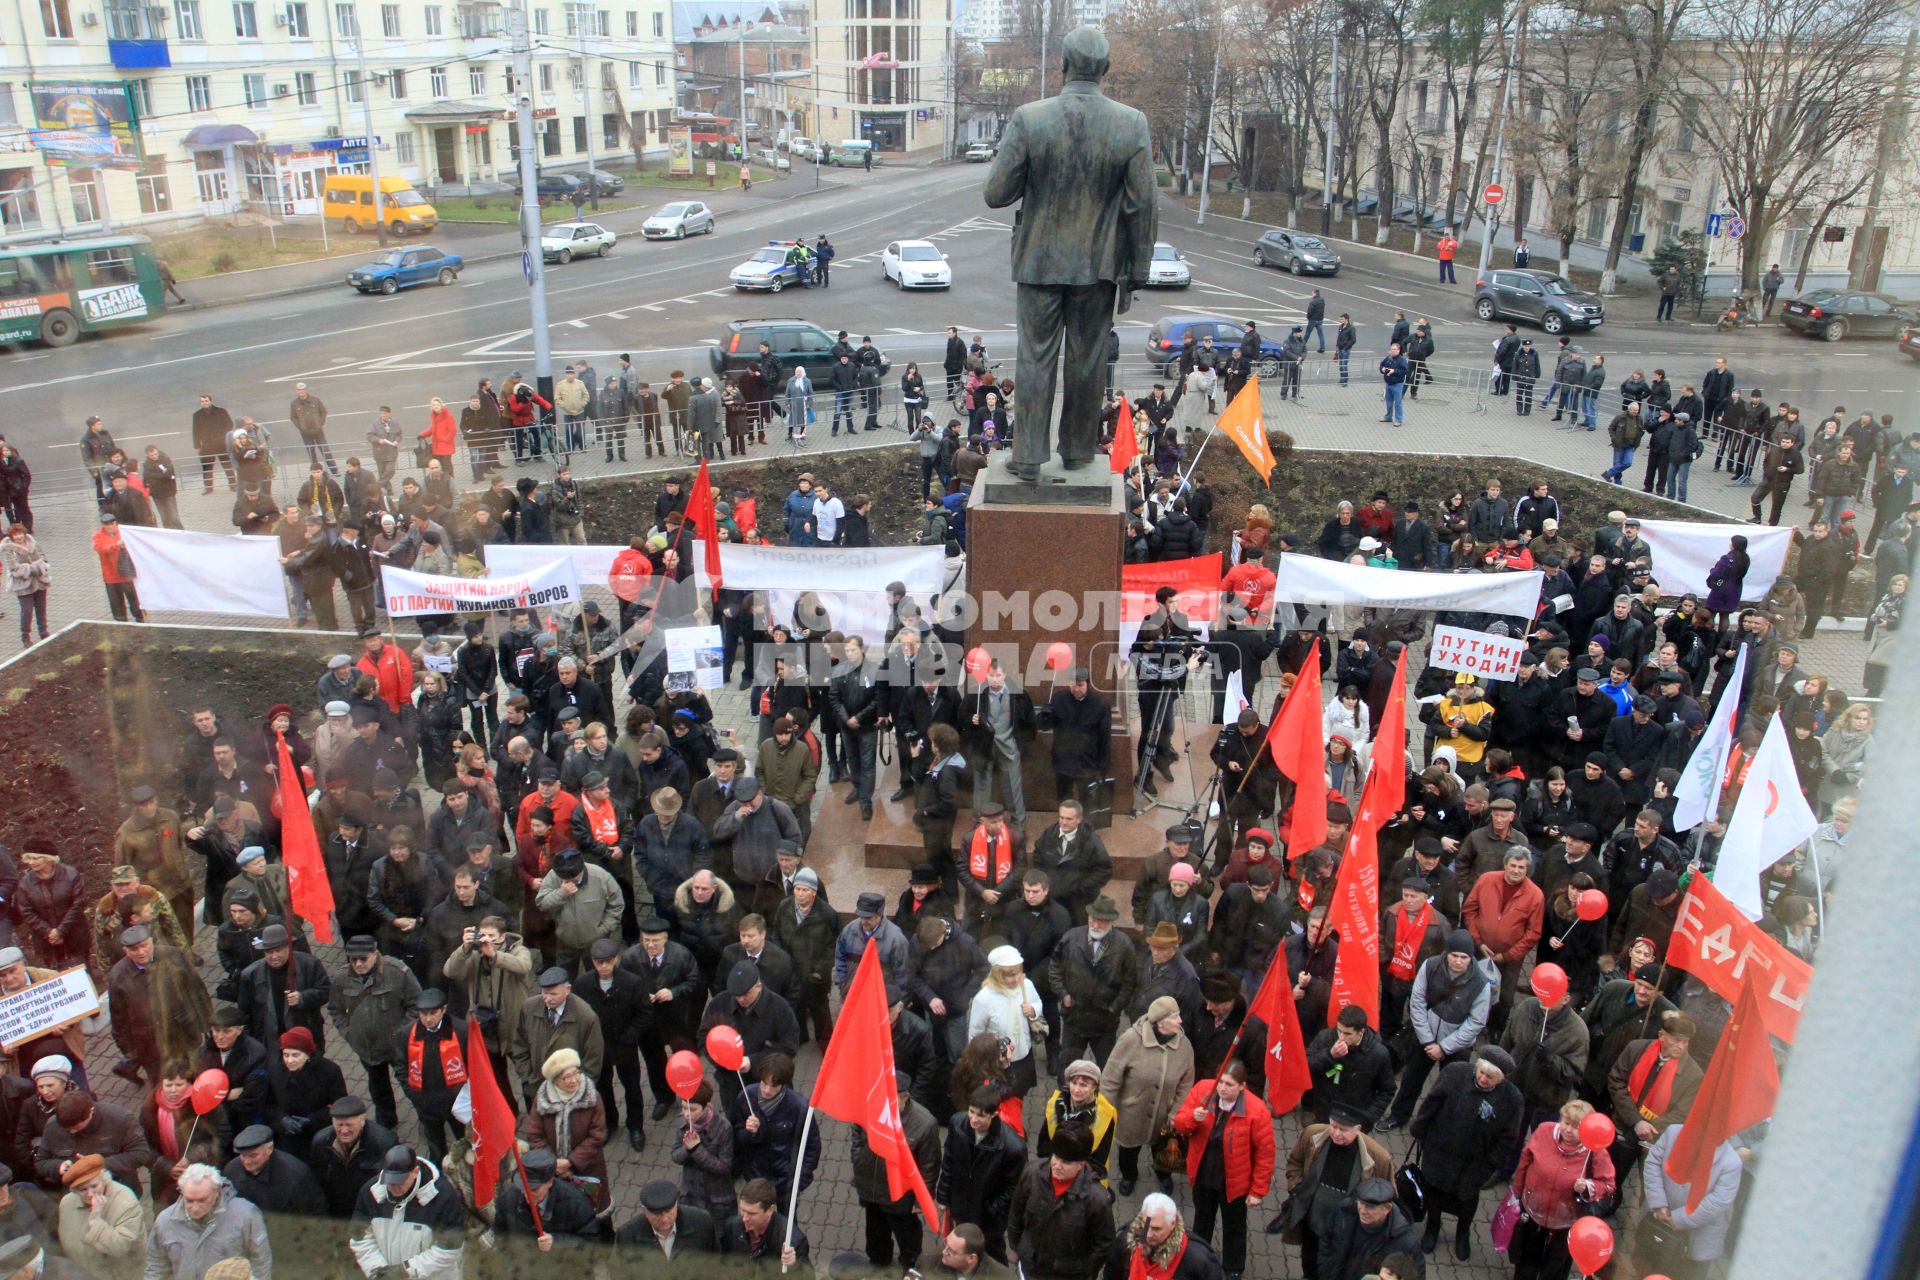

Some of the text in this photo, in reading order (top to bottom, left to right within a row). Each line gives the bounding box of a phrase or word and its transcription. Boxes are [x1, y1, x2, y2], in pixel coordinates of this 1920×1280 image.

[342, 137, 379, 148] АПТЕА
[97, 284, 143, 309] БАНК
[102, 299, 147, 316] АВАНГАРД
[425, 579, 531, 596] ЗАЩИТИМ НАРОД
[390, 585, 569, 612] ОТ ПАРТИИ ЖУЛИКОВ И ВОРОВ
[1441, 635, 1510, 658] ПУТИН
[25, 978, 64, 998] ОГРОМНАЯ
[10, 993, 52, 1016] СМЕРТНЫЙ
[52, 987, 68, 999] БОЙ
